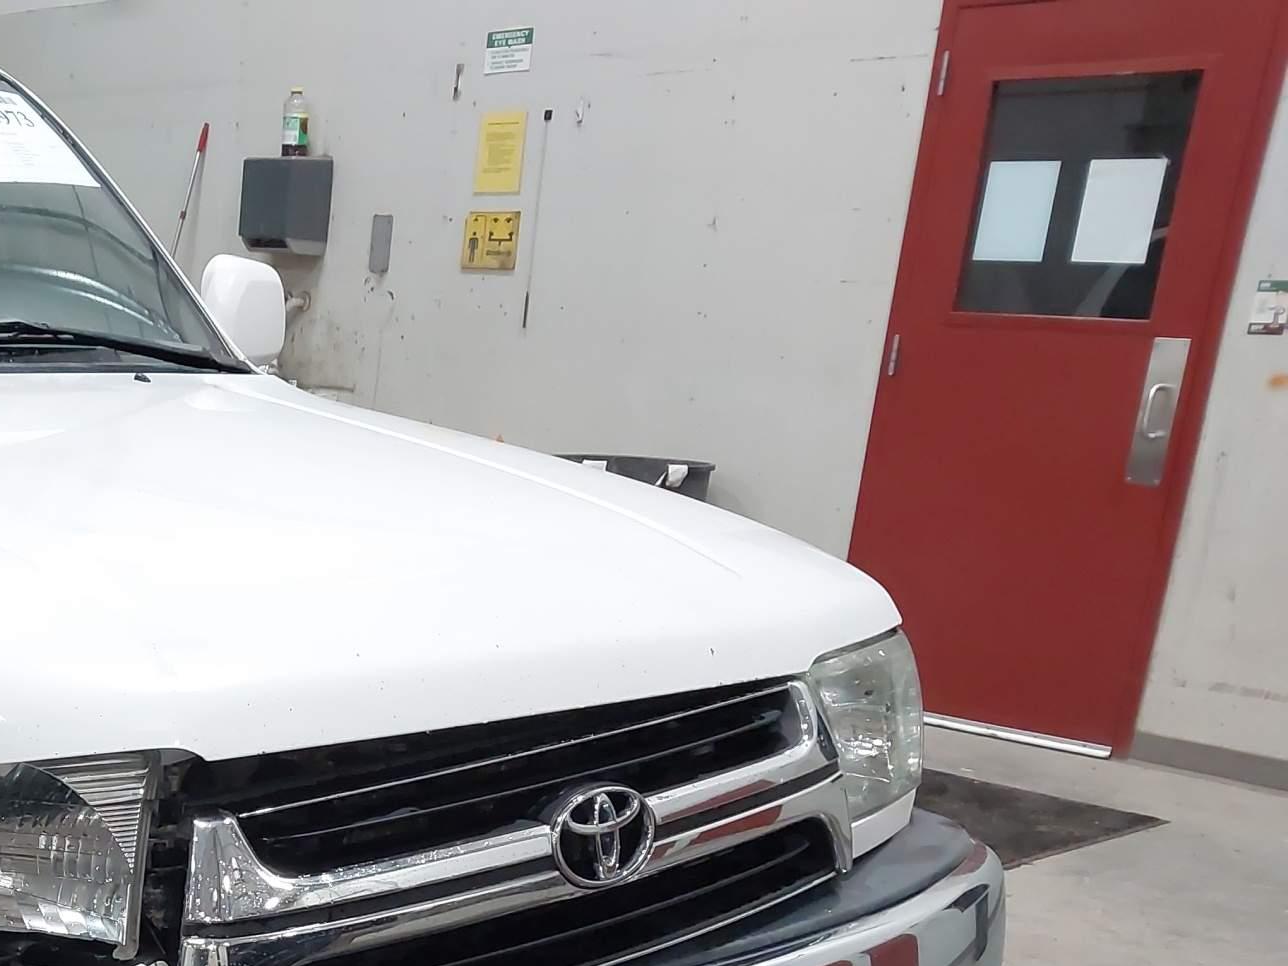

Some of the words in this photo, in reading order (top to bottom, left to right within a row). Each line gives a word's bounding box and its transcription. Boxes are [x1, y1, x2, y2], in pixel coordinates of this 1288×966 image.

[492, 31, 530, 40] EMERGENCY
[494, 39, 507, 47] EYE
[507, 37, 527, 46] WASH
